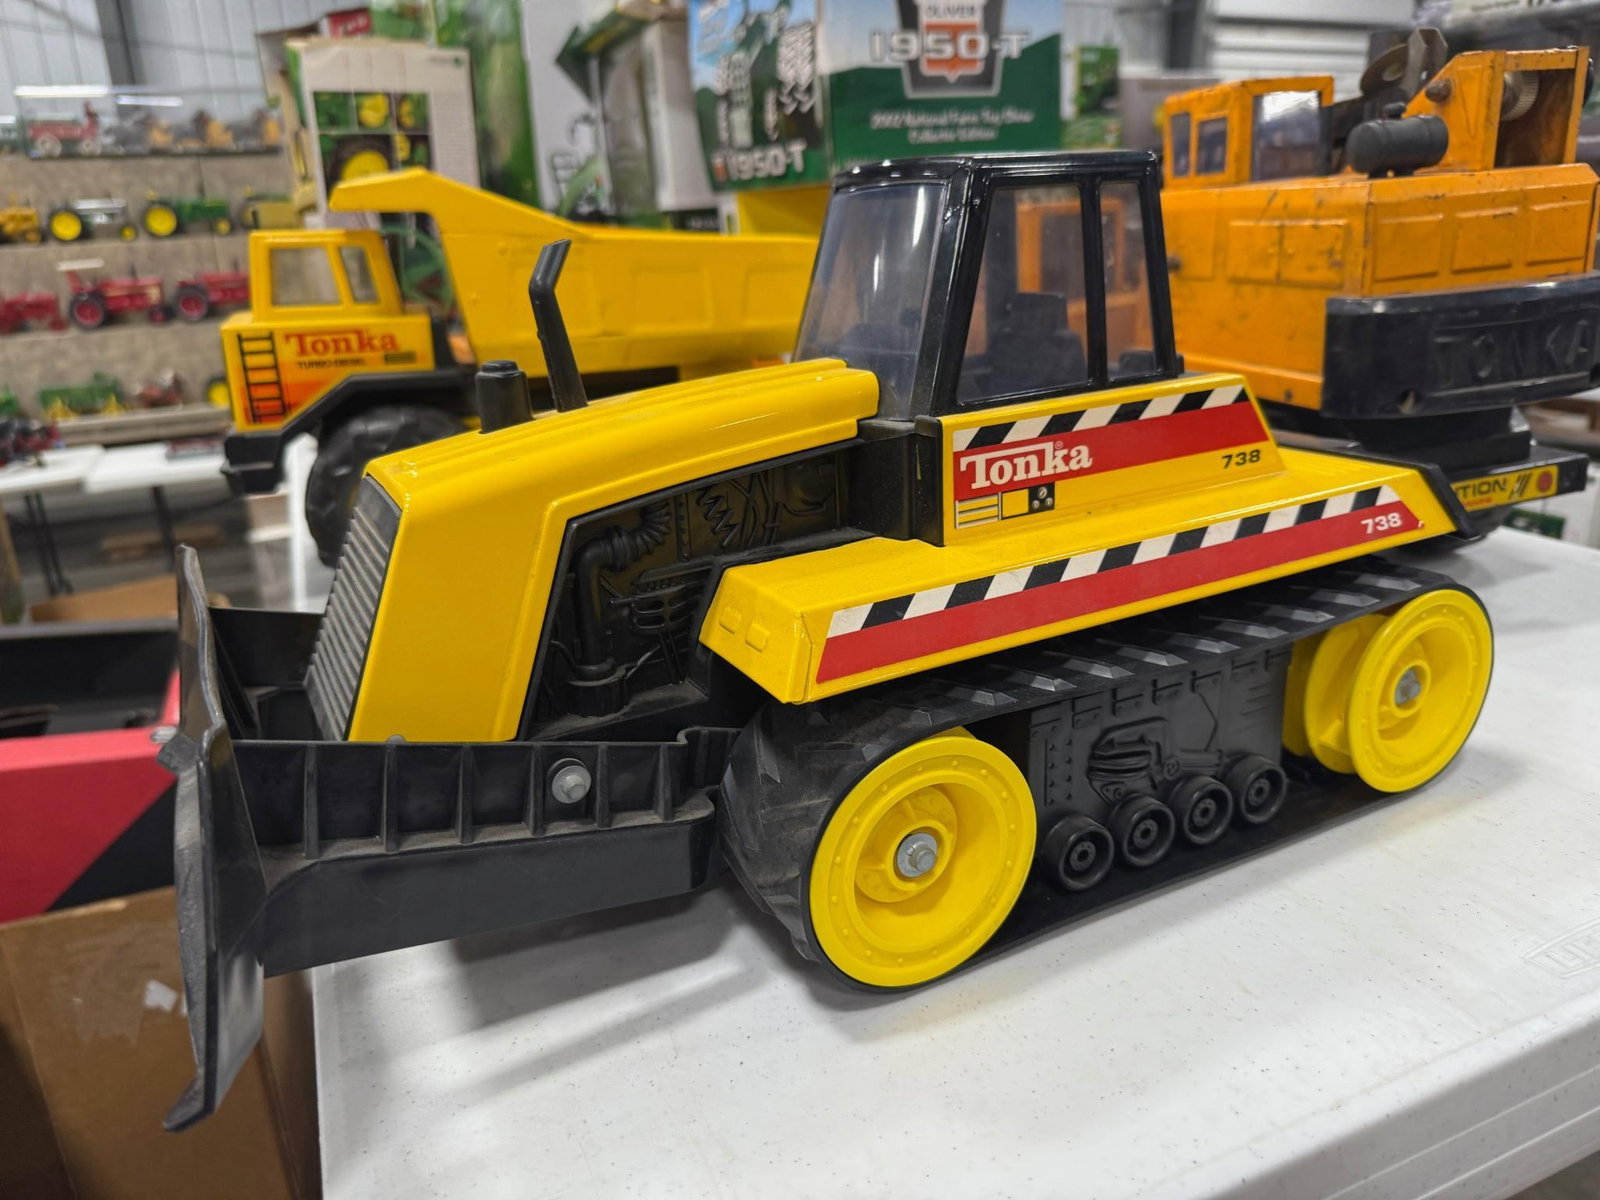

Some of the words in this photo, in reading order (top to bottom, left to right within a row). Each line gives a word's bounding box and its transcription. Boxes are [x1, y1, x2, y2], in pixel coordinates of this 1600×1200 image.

[927, 4, 976, 18] OLIVER
[868, 30, 1031, 62] 1950-T
[727, 139, 808, 180] 1950-T
[284, 328, 401, 357] Tonka
[1433, 318, 1600, 388] TONKA
[960, 440, 1093, 490] Tonka
[1221, 449, 1262, 470] 738
[1456, 477, 1508, 499] TION
[1361, 512, 1403, 535] 738
